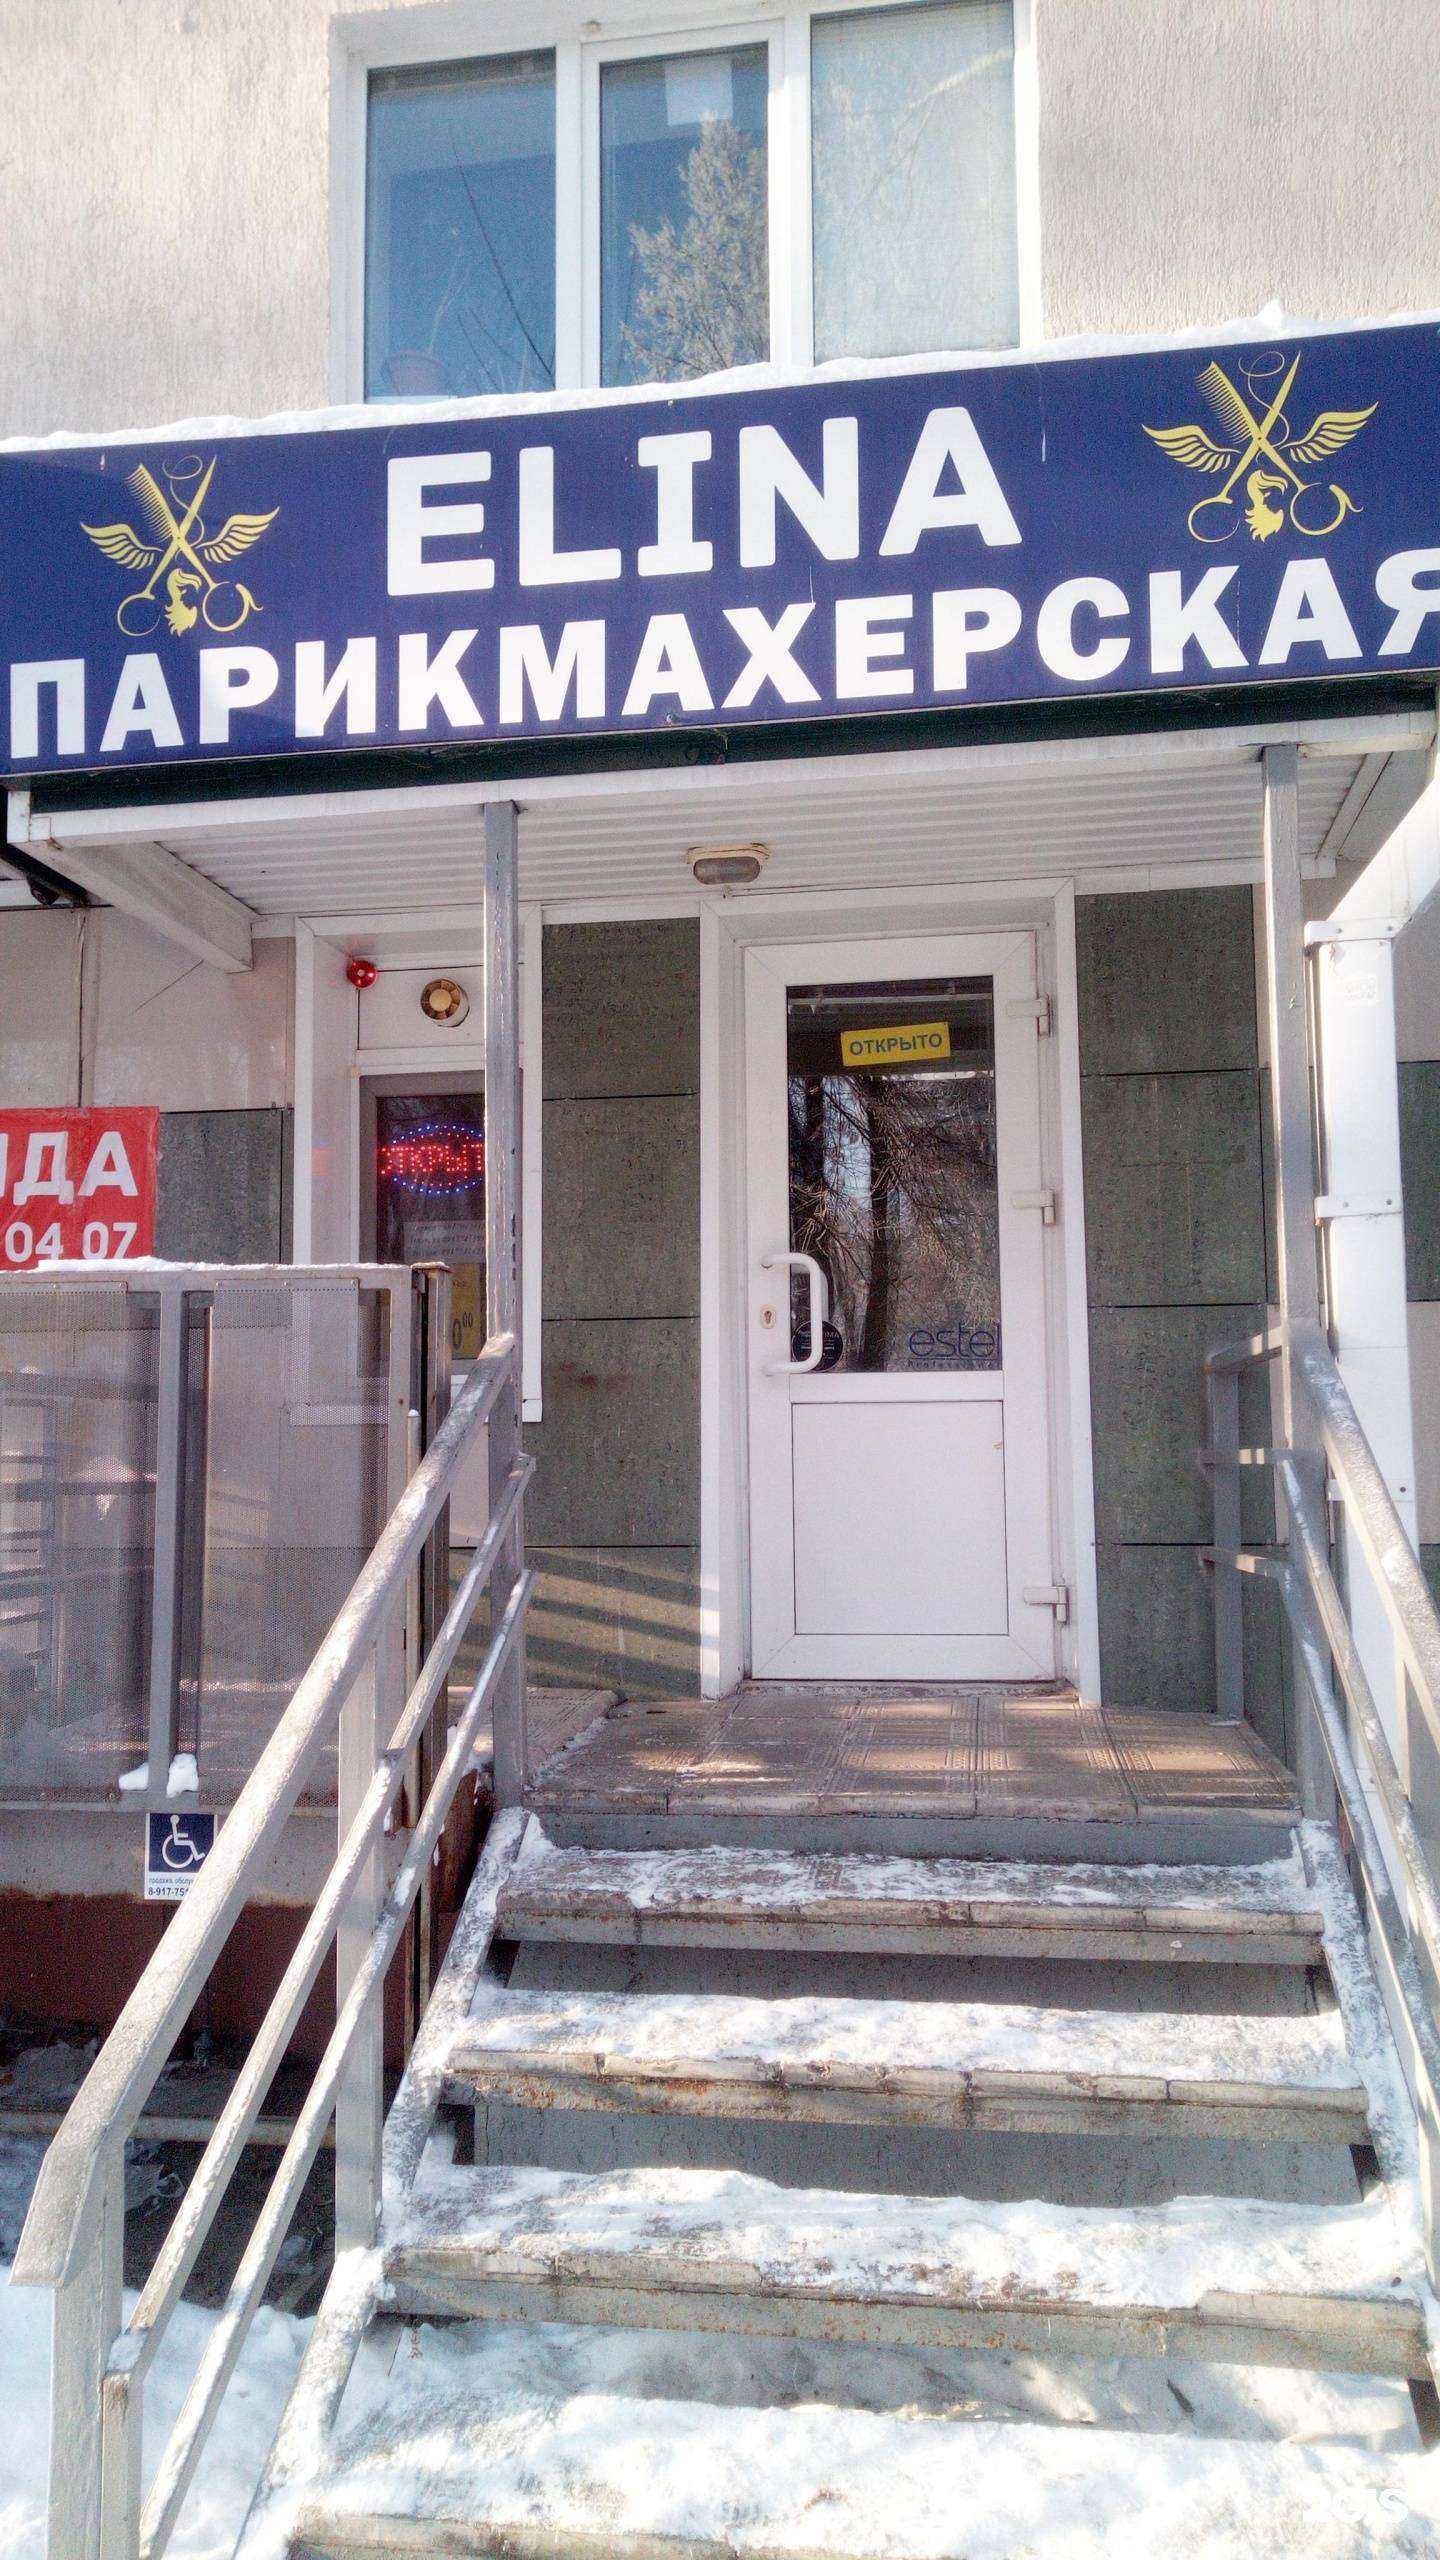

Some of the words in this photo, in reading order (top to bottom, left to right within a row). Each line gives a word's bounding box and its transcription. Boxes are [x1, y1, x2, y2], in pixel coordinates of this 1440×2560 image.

[387, 406, 1022, 597] ELINA
[10, 548, 1440, 759] ПАРИКМАХЕРСКАЯ
[849, 1032, 943, 1056] ОТКРЫТО
[0, 1131, 138, 1205] ДА
[5, 1221, 64, 1263] 04
[82, 1221, 138, 1259] 07
[148, 1886, 189, 1897] 8-917-75
